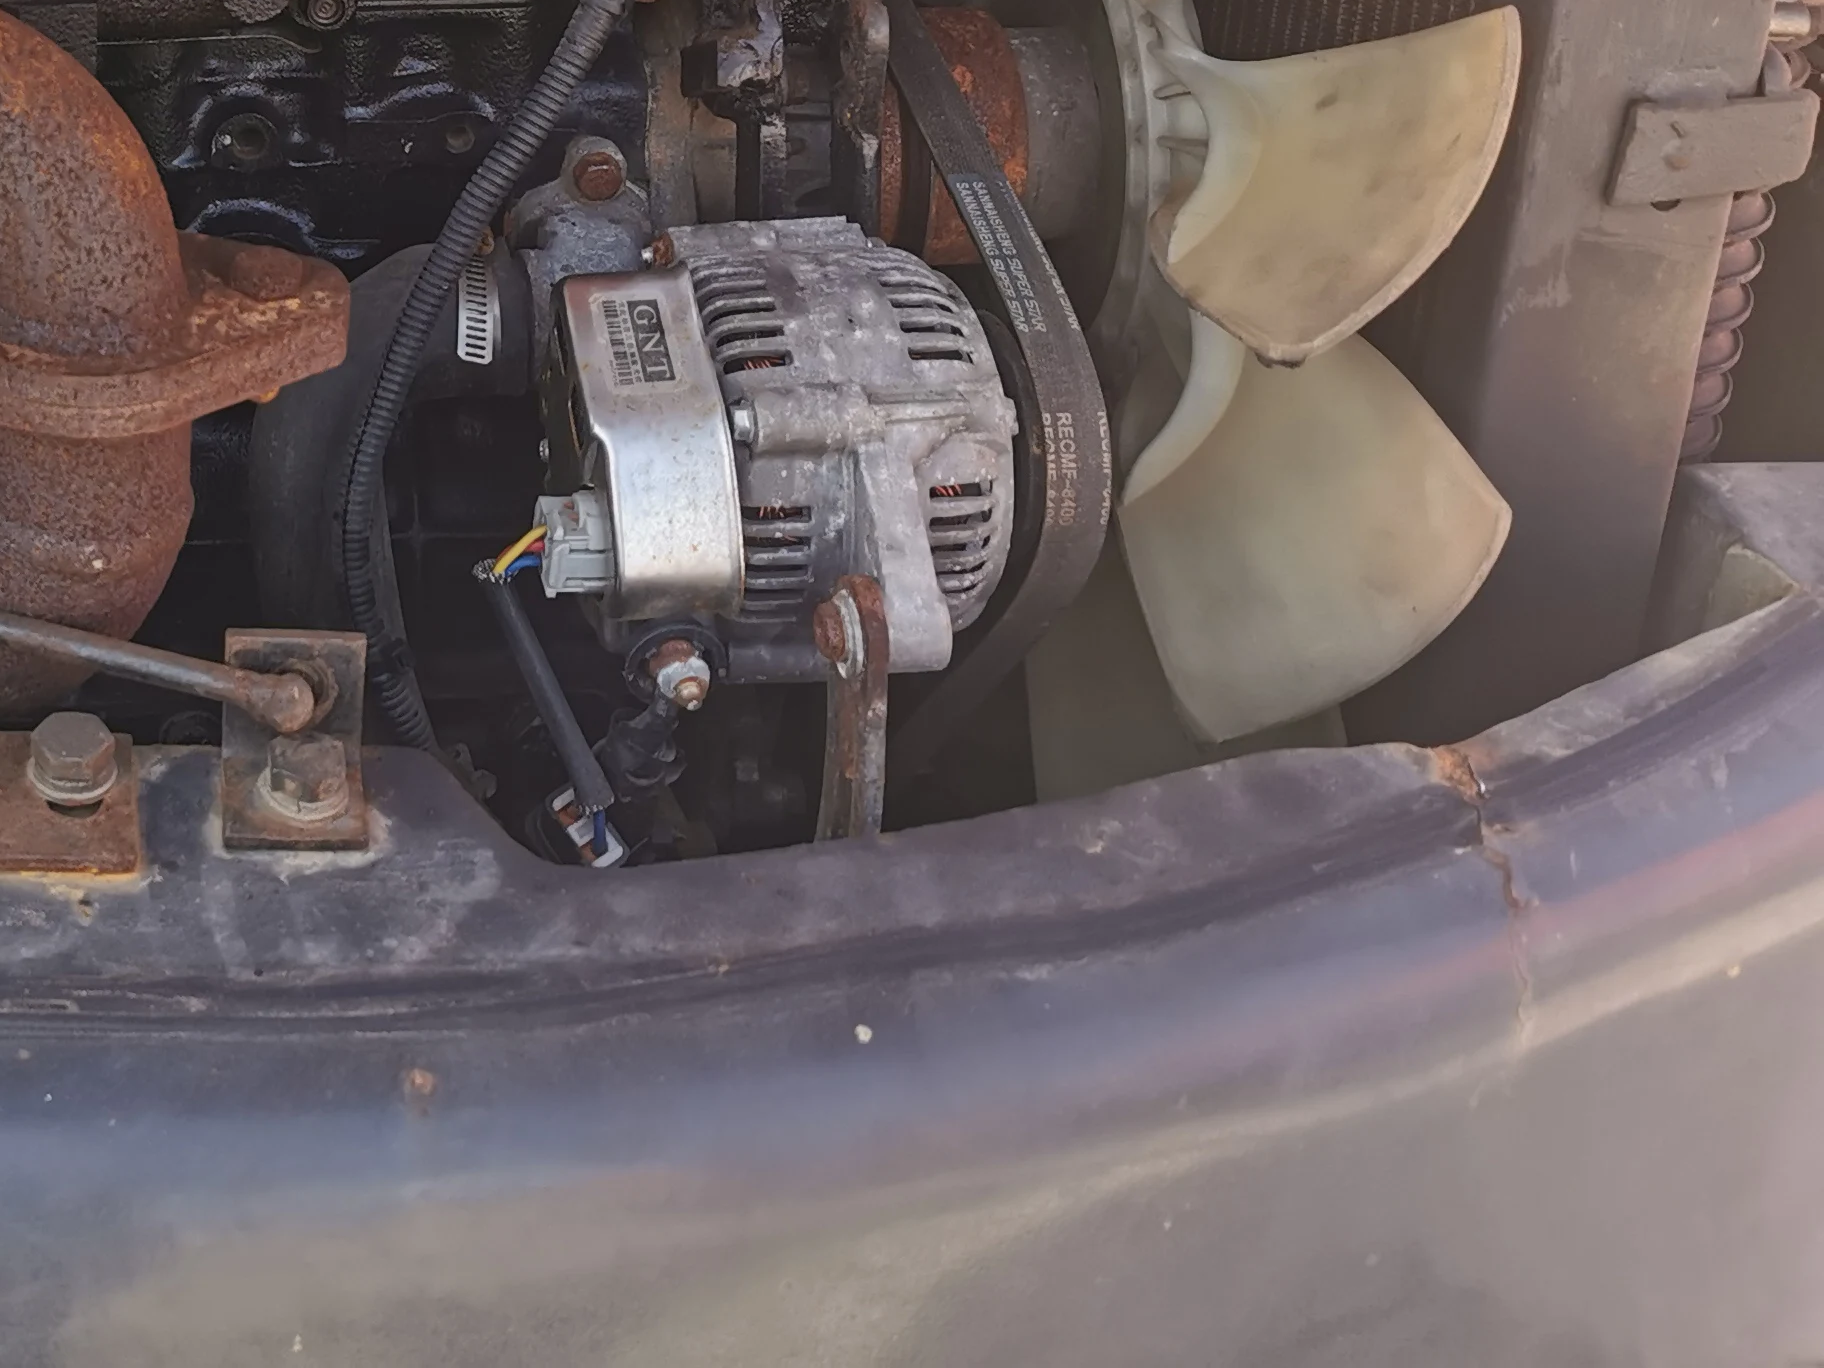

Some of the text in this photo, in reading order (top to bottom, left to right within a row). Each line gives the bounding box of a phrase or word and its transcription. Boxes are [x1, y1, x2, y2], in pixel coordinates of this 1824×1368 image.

[990, 257, 1016, 299] SUPER
[1007, 298, 1029, 332] STAR
[1006, 257, 1034, 298] SUPER
[1024, 298, 1047, 332] STAR
[633, 304, 671, 378] GNT
[1056, 411, 1077, 526] RECMF-8400
